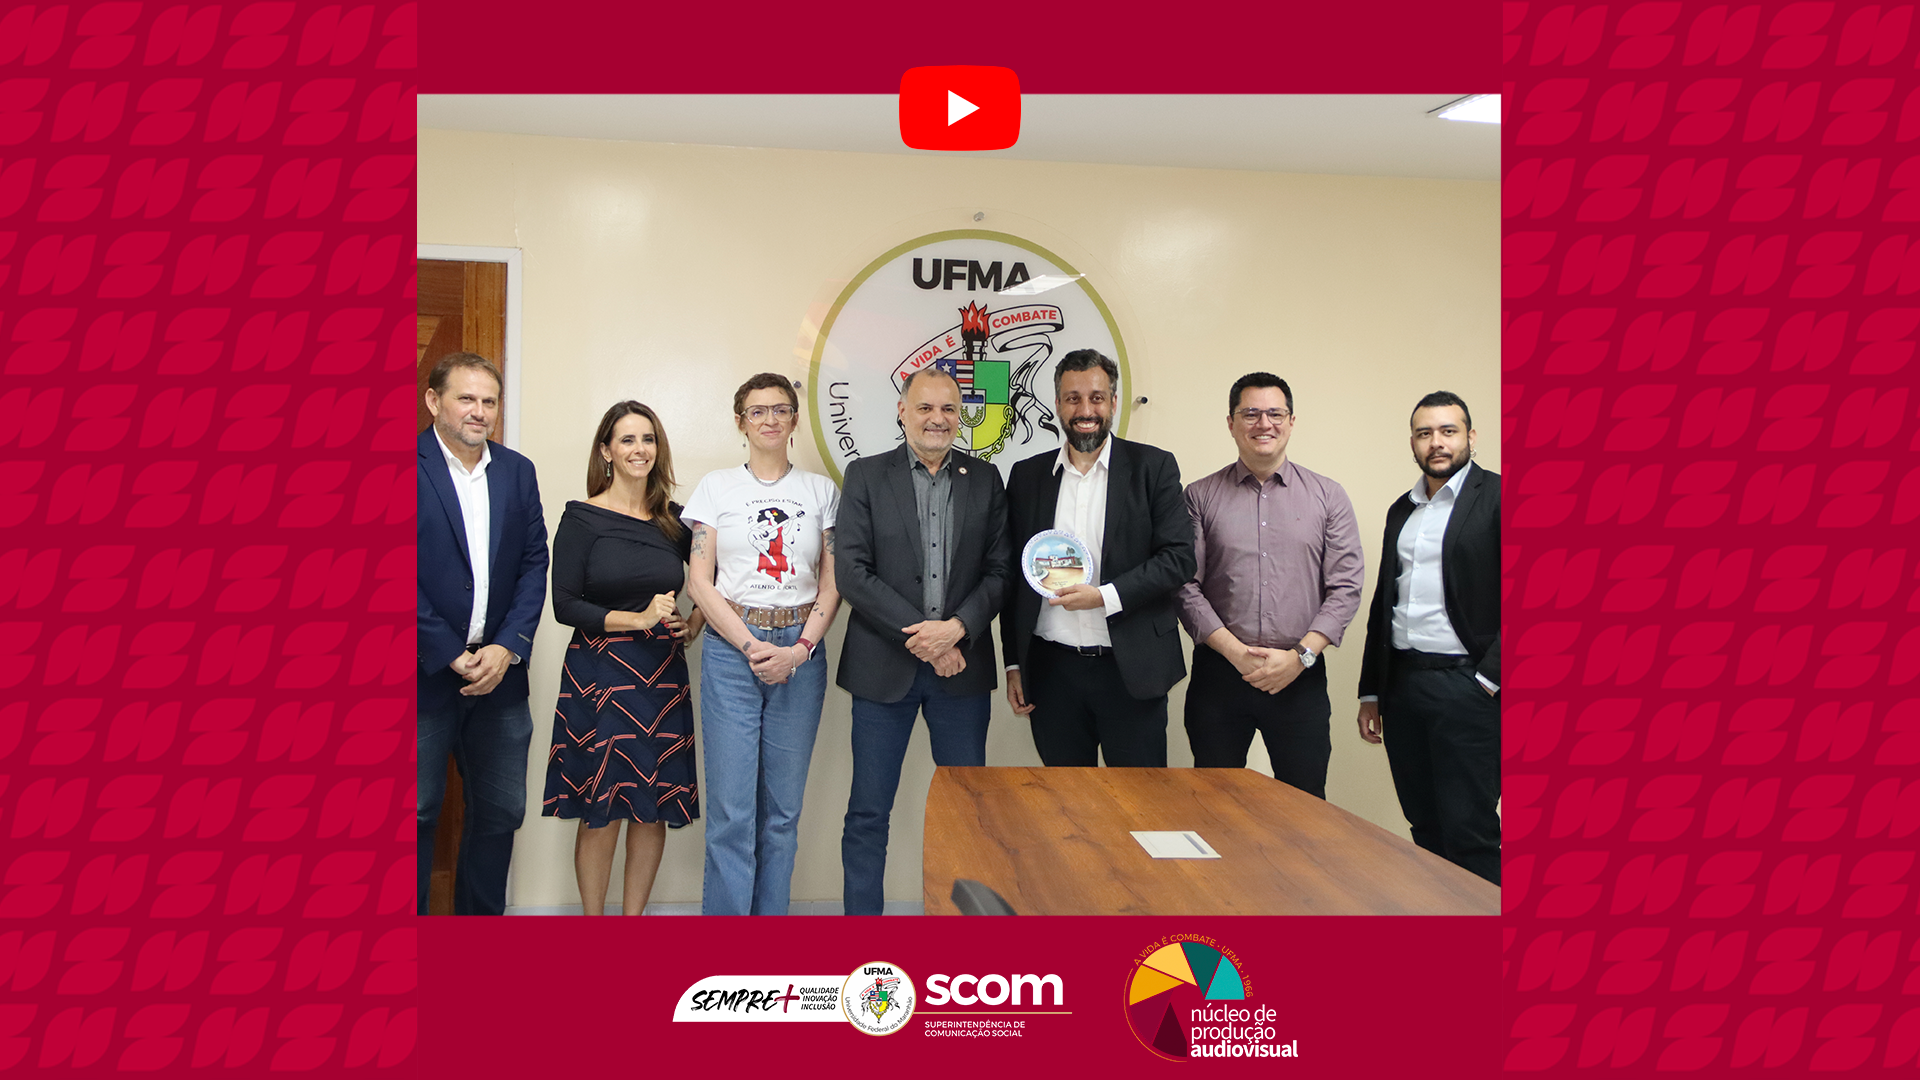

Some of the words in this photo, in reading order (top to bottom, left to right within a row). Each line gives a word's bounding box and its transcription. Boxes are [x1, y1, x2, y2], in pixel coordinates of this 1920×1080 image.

[913, 257, 1035, 293] UFMA
[900, 370, 911, 381] A
[910, 345, 943, 369] VIDA
[945, 335, 956, 348] É
[992, 310, 1057, 329] COMBATE
[829, 382, 861, 458] Univer
